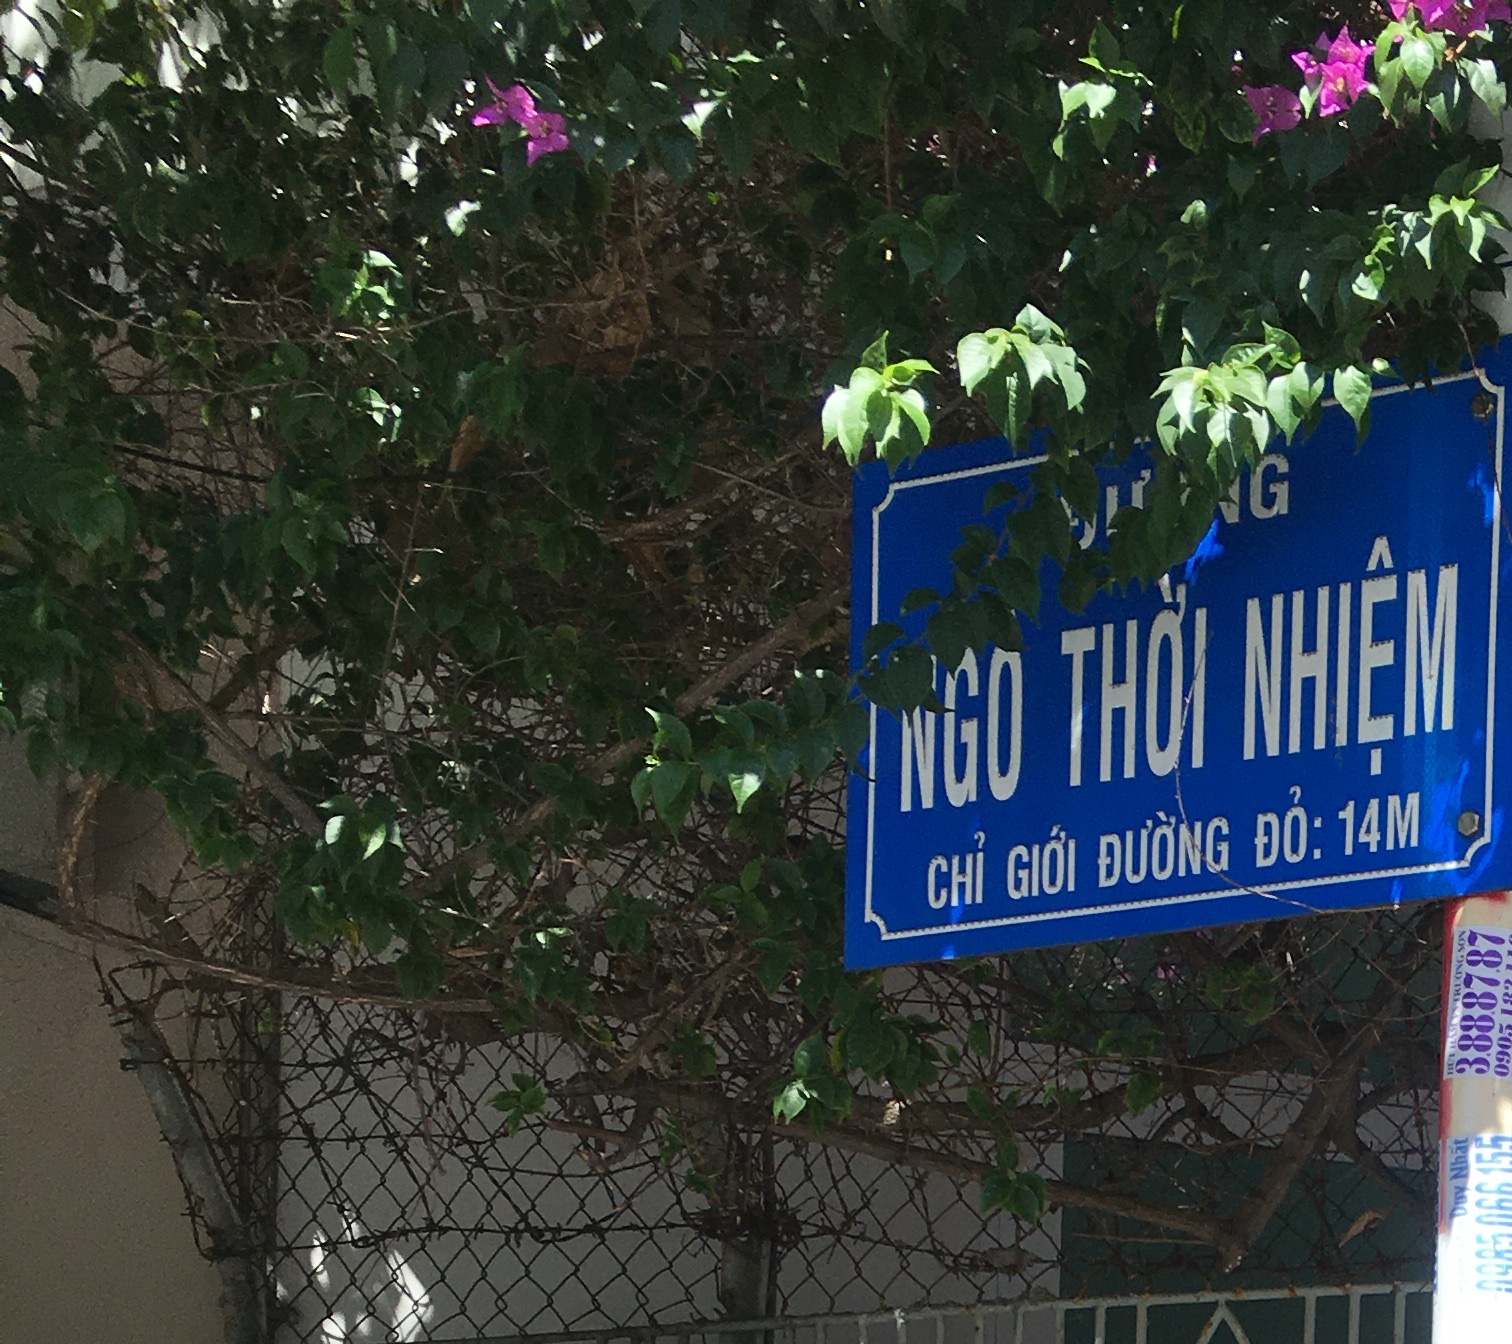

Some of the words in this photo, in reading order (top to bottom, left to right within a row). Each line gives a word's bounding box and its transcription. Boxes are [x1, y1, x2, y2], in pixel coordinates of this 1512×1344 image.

[1060, 573, 1208, 787] THỜI
[1243, 536, 1459, 776] NHIỆM
[928, 831, 984, 909] CHỈ
[1007, 823, 1077, 900] GIỚI
[1099, 810, 1230, 884] ĐƯỜNG
[1338, 791, 1420, 855] 14M
[1454, 929, 1506, 1075] 3.88.87.87
